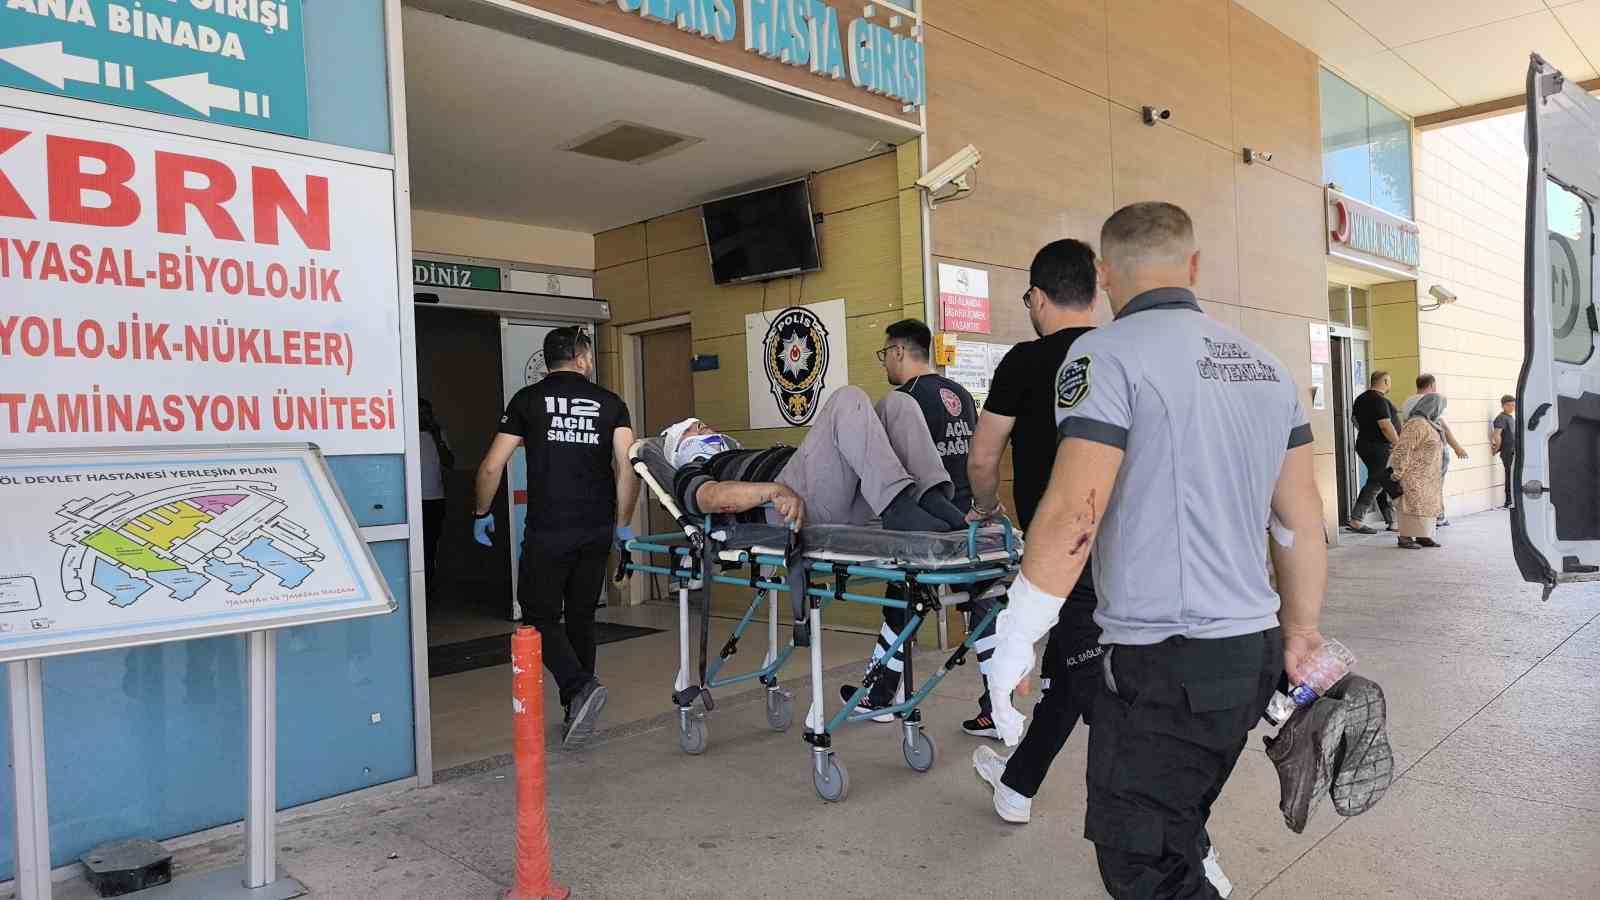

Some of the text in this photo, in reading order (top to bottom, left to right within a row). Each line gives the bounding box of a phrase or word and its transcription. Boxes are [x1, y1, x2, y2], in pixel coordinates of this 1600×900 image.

[107, 1, 246, 61] BİNADA
[414, 262, 472, 288] DİNİZ
[778, 313, 811, 331] POLİS
[0, 384, 397, 433] TAMİNASYON ÜNİTESİ
[544, 396, 601, 417] 112
[551, 416, 596, 431] ACİL
[546, 429, 600, 445] SAĞLIK
[24, 473, 82, 485] DEVLET
[86, 469, 167, 482] HASTANESİ
[169, 467, 237, 479] YERLEŞİM
[239, 466, 278, 476] PLANI
